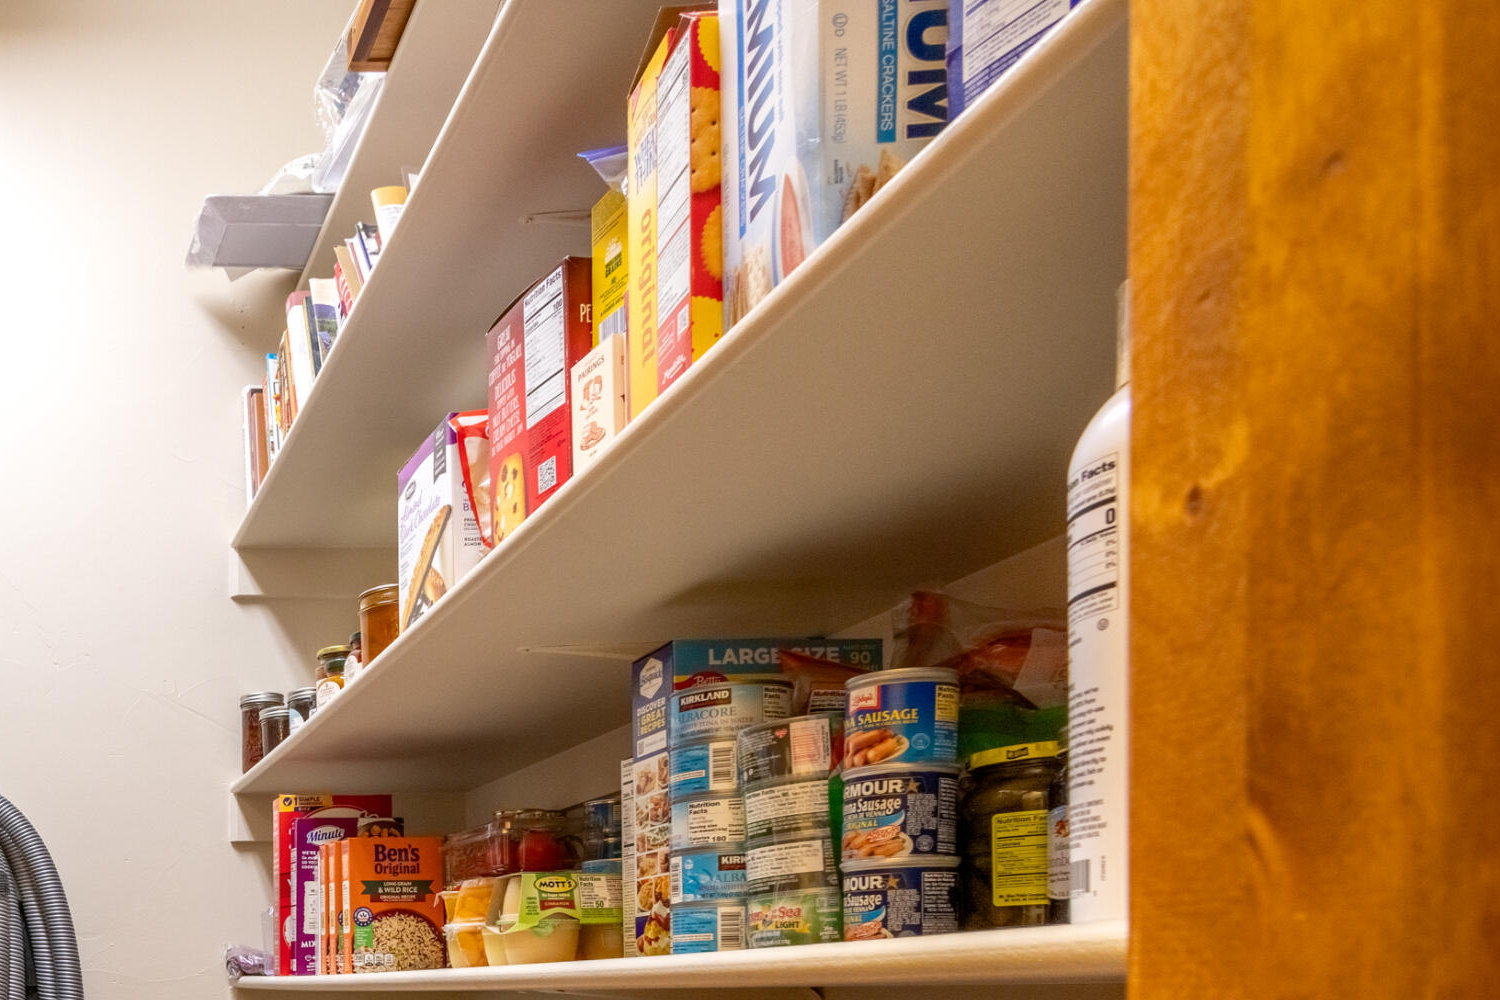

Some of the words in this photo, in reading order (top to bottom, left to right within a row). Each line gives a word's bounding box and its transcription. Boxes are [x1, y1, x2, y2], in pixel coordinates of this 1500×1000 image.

[833, 48, 847, 66] NET
[906, 0, 948, 139] UM
[833, 70, 847, 87] WT
[881, 54, 895, 131] CRACKERS
[747, 0, 776, 224] MIUM
[833, 99, 847, 112] LB
[639, 207, 657, 368] original
[577, 355, 605, 382] PAIRINGS
[1081, 460, 1116, 482] Facts
[1104, 507, 1116, 525] 0
[708, 648, 781, 666] LARGE
[850, 651, 872, 665] 90
[636, 696, 666, 717] DISCOVER
[680, 690, 730, 706] KIRKLAND
[641, 706, 665, 726] GREAT
[676, 706, 737, 723] ALBACORE
[857, 708, 919, 724] SAUSAGE
[640, 719, 665, 736] RECIPES
[857, 798, 902, 814] Sausage
[306, 828, 345, 843] Minute
[373, 843, 420, 863] Ben's
[374, 862, 420, 877] Original
[540, 881, 572, 889] MOTT'S
[846, 894, 882, 909] Sausage
[778, 906, 802, 918] Sea
[775, 921, 800, 929] LIGHT
